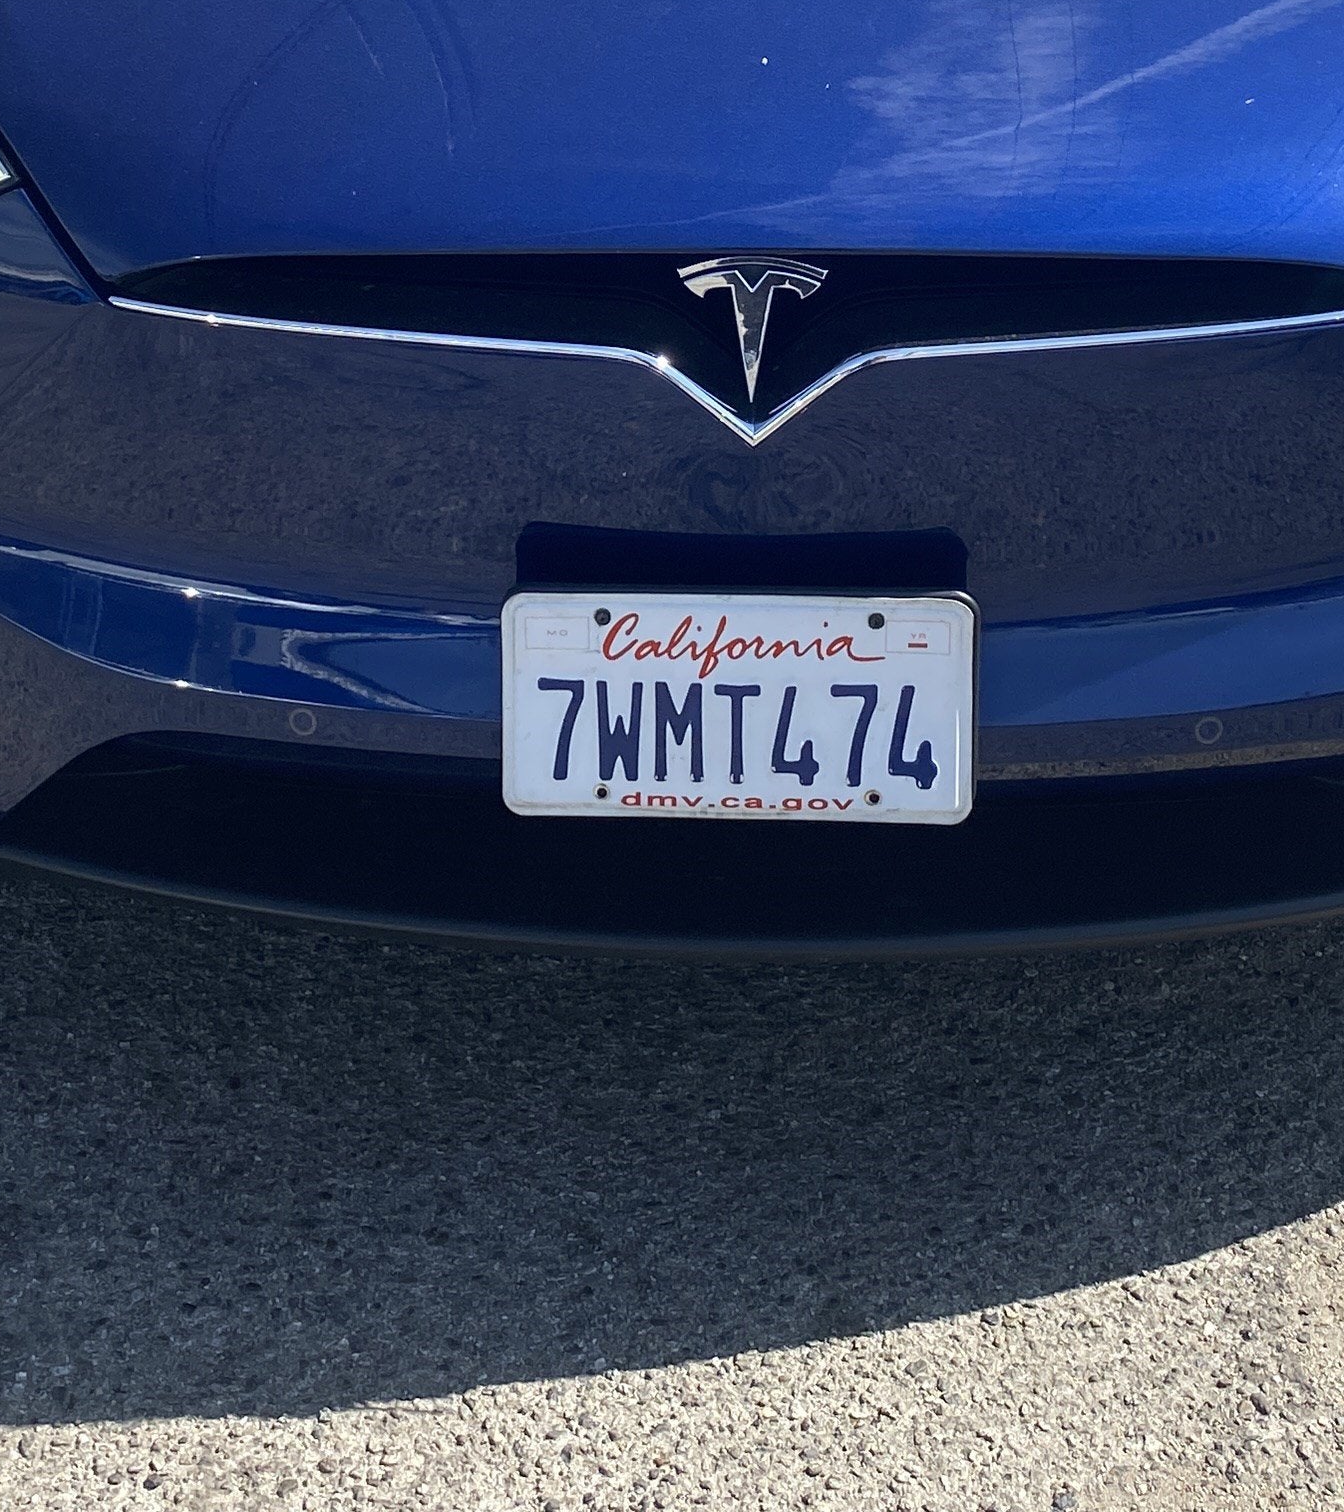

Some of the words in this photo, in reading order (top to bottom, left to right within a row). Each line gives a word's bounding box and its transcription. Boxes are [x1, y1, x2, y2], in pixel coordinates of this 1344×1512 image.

[601, 612, 886, 679] California
[537, 677, 940, 790] 7WMT474
[620, 791, 855, 812] dmv.ca.gov
